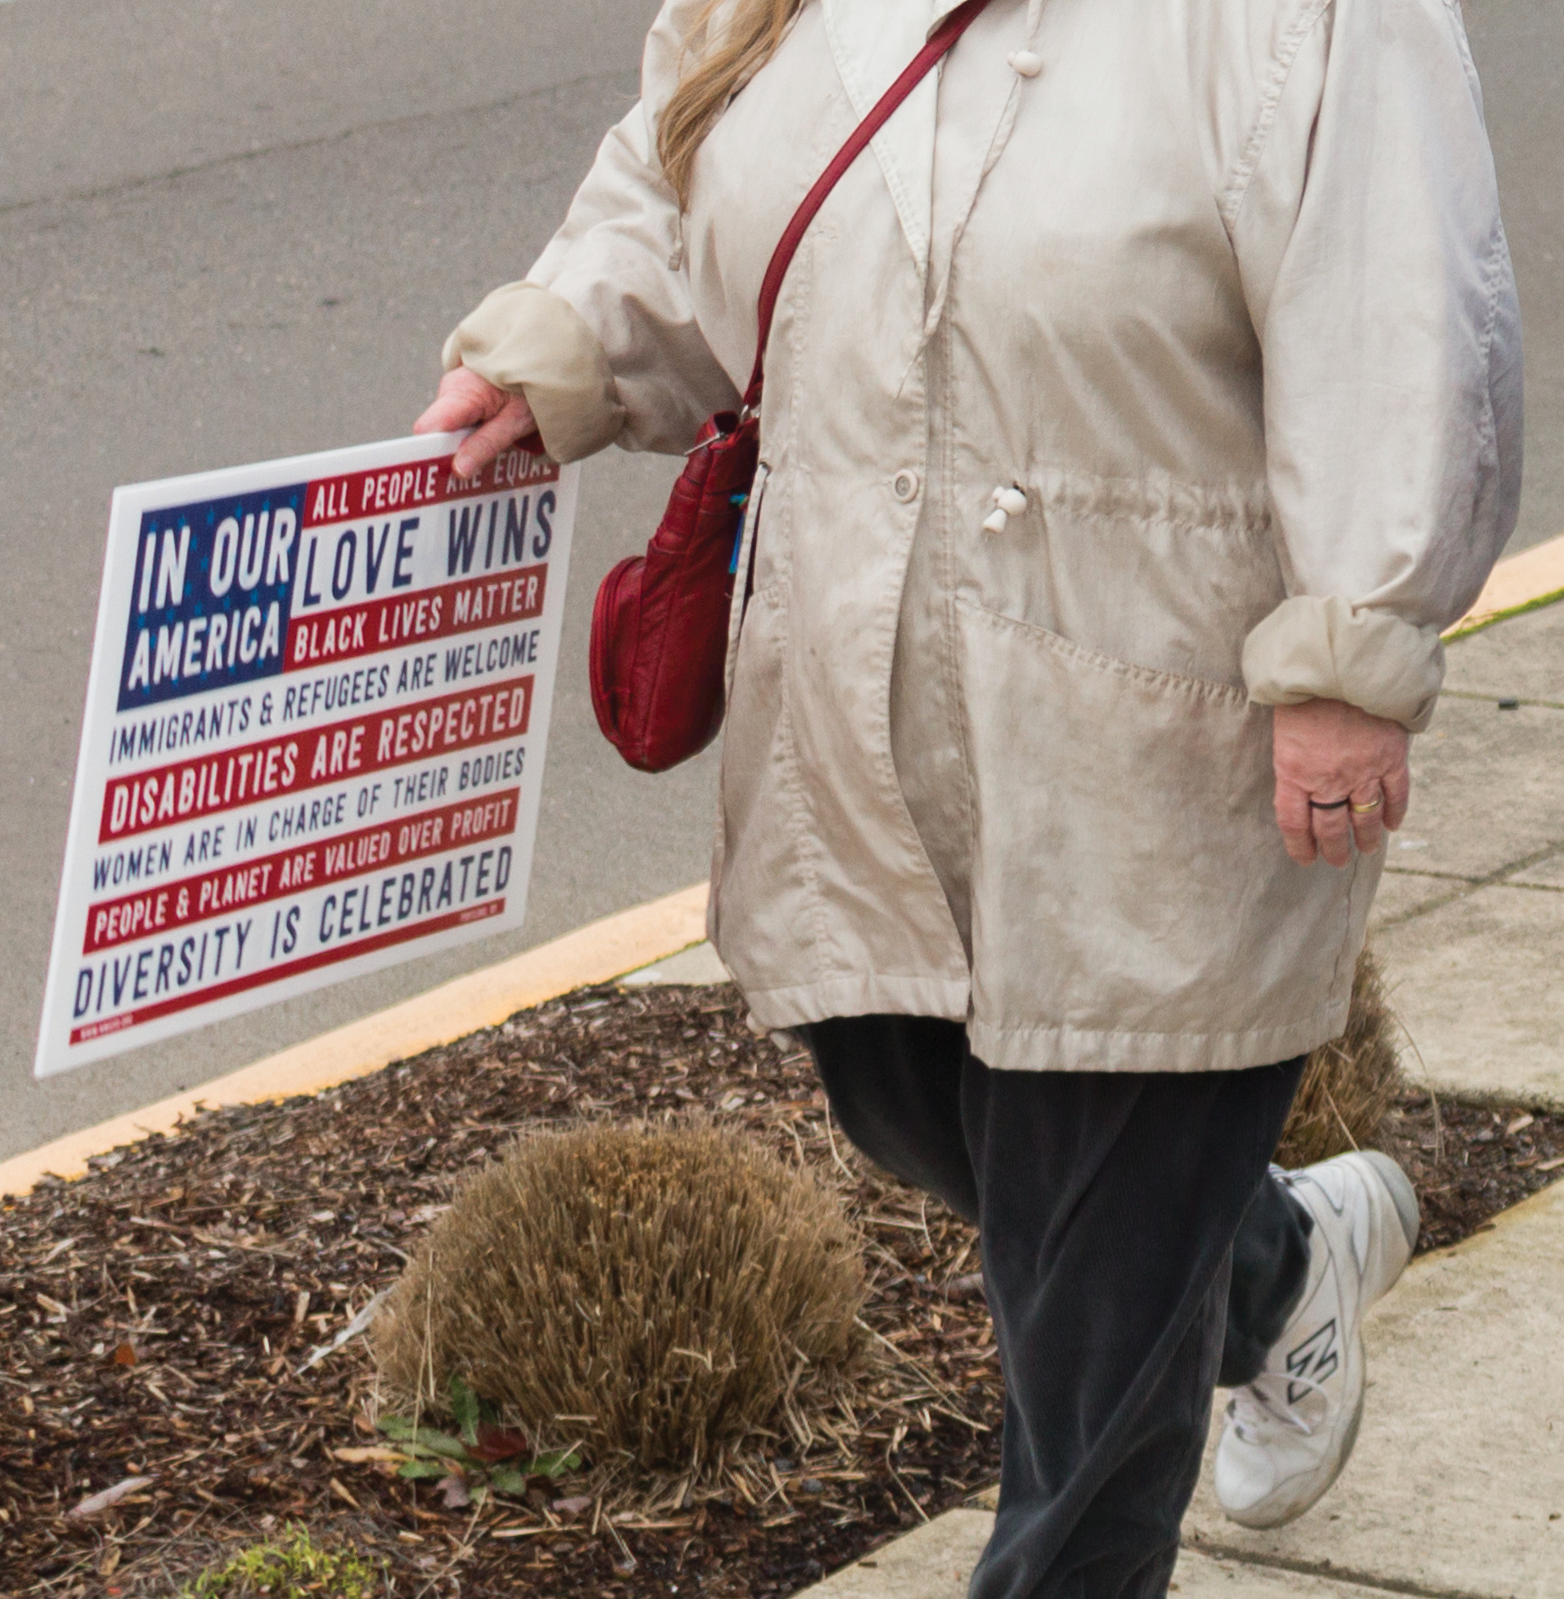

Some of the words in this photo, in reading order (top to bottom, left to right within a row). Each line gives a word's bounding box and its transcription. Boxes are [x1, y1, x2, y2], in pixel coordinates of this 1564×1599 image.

[303, 517, 420, 608] LOVE
[448, 490, 556, 577] WINS
[312, 481, 349, 521] ALL
[361, 465, 439, 511] PEOPLE
[139, 525, 191, 613] IN
[209, 507, 296, 597] OUR
[294, 612, 367, 663] BLACK
[379, 596, 442, 643] LIVES
[453, 575, 538, 626] MATTER
[109, 696, 252, 765] IMMIGRANTS
[260, 692, 273, 725] &
[283, 664, 390, 721] REFUGEES
[397, 653, 437, 694] ARE
[445, 629, 540, 682] WELCOME
[128, 601, 280, 690] AMERICA
[94, 839, 172, 891] WOMEN
[184, 826, 225, 866] ARE
[236, 815, 257, 851] IN
[268, 793, 347, 842] CHARGE
[358, 783, 381, 818] OF
[394, 766, 449, 809] THEIR
[459, 746, 525, 791] BODIES
[110, 742, 298, 833] DISABILITIES
[311, 725, 365, 779] ARE
[377, 687, 525, 762] RESPECTED
[73, 918, 252, 1019] DIVERSITY
[270, 905, 301, 960] IS
[319, 845, 512, 943] CELEBRATED
[94, 892, 169, 944] PEOPLE
[176, 886, 190, 920] &
[199, 863, 273, 914] PLANET
[279, 852, 316, 890] ARE
[325, 831, 391, 876] VALUED
[398, 817, 443, 855] OVER
[450, 799, 512, 841] PROFIT
